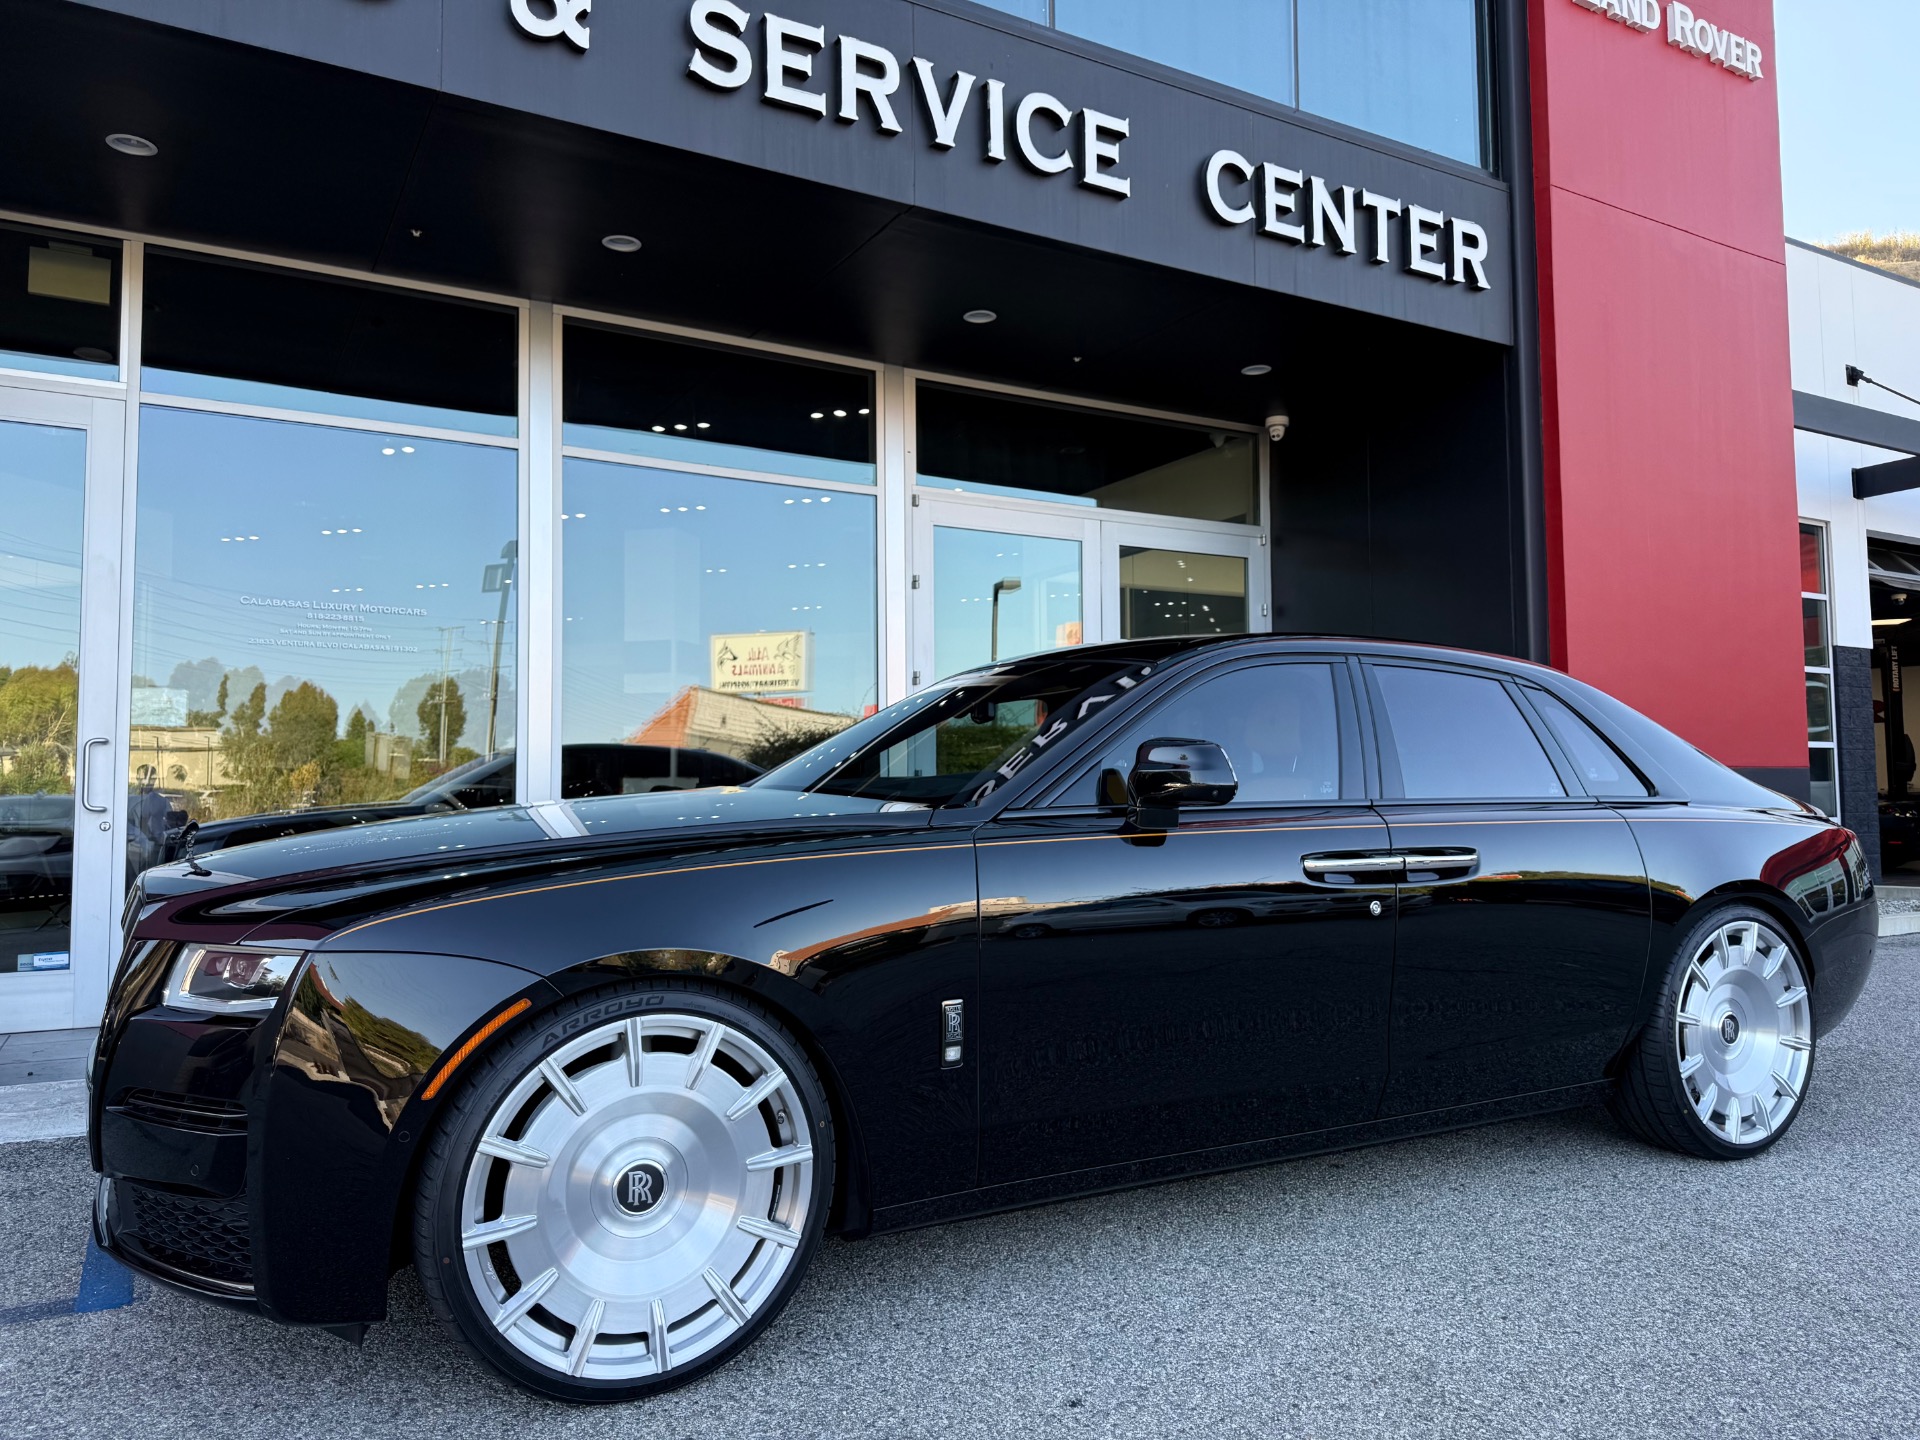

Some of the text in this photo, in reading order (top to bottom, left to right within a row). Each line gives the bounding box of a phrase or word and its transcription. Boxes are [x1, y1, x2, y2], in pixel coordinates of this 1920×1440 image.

[1667, 1, 1764, 82] ROVER
[687, 0, 1131, 199] SERVICE
[1203, 149, 1491, 291] CENTER
[240, 595, 427, 617] CALABASAS LUXURY MOTORCARS
[306, 612, 365, 622] 818-223-8815
[275, 639, 315, 648] VENTURA
[316, 641, 338, 649] BLVD
[541, 995, 665, 1050] ARROYO
